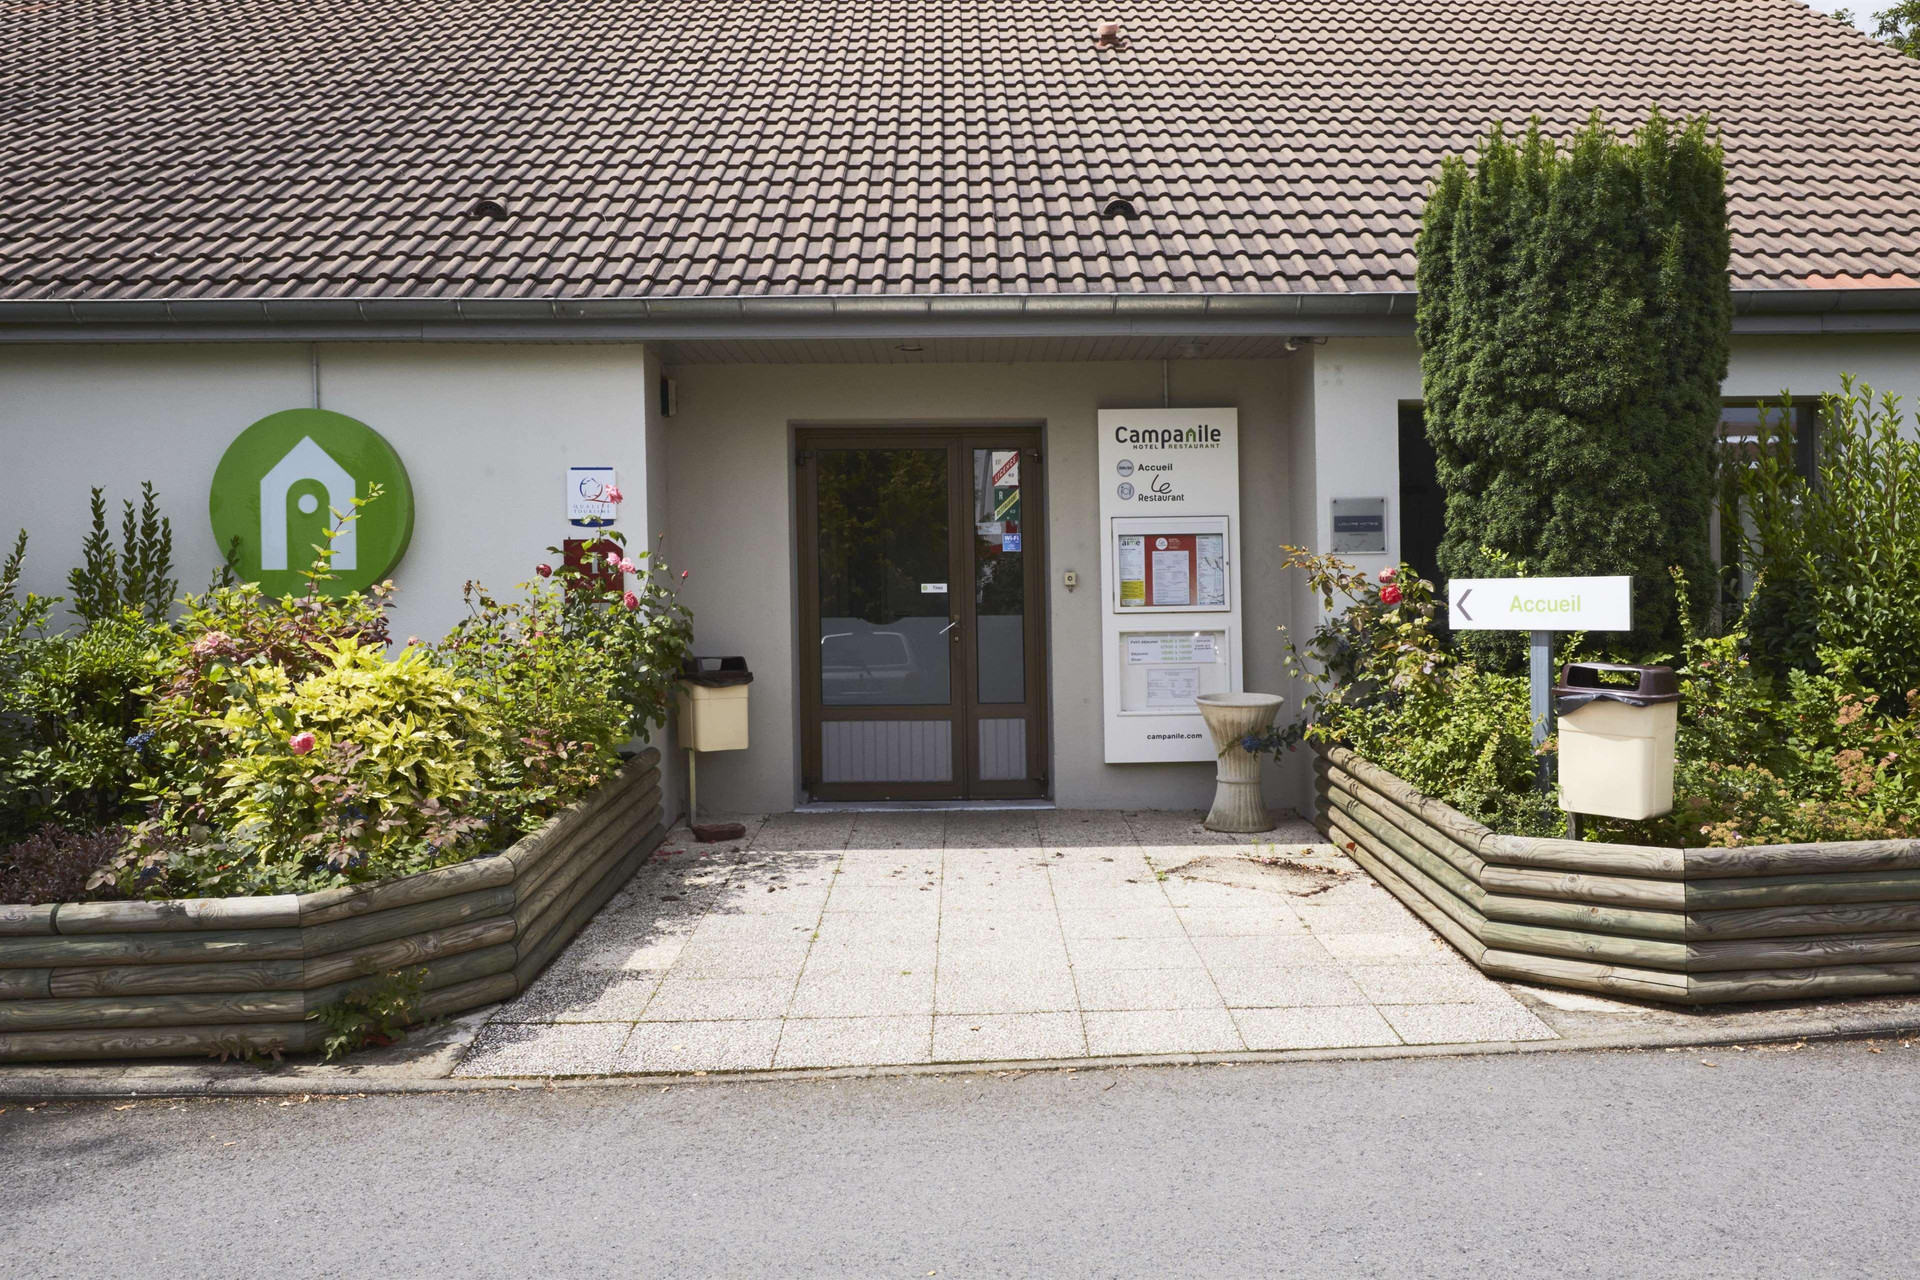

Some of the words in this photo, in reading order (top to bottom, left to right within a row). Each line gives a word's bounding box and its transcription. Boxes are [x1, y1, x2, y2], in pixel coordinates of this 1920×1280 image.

[1115, 424, 1221, 449] Campanile
[994, 454, 1016, 482] LICENCE
[1138, 463, 1173, 471] Accueil
[998, 491, 1003, 500] R
[1509, 594, 1581, 612] Accueil
